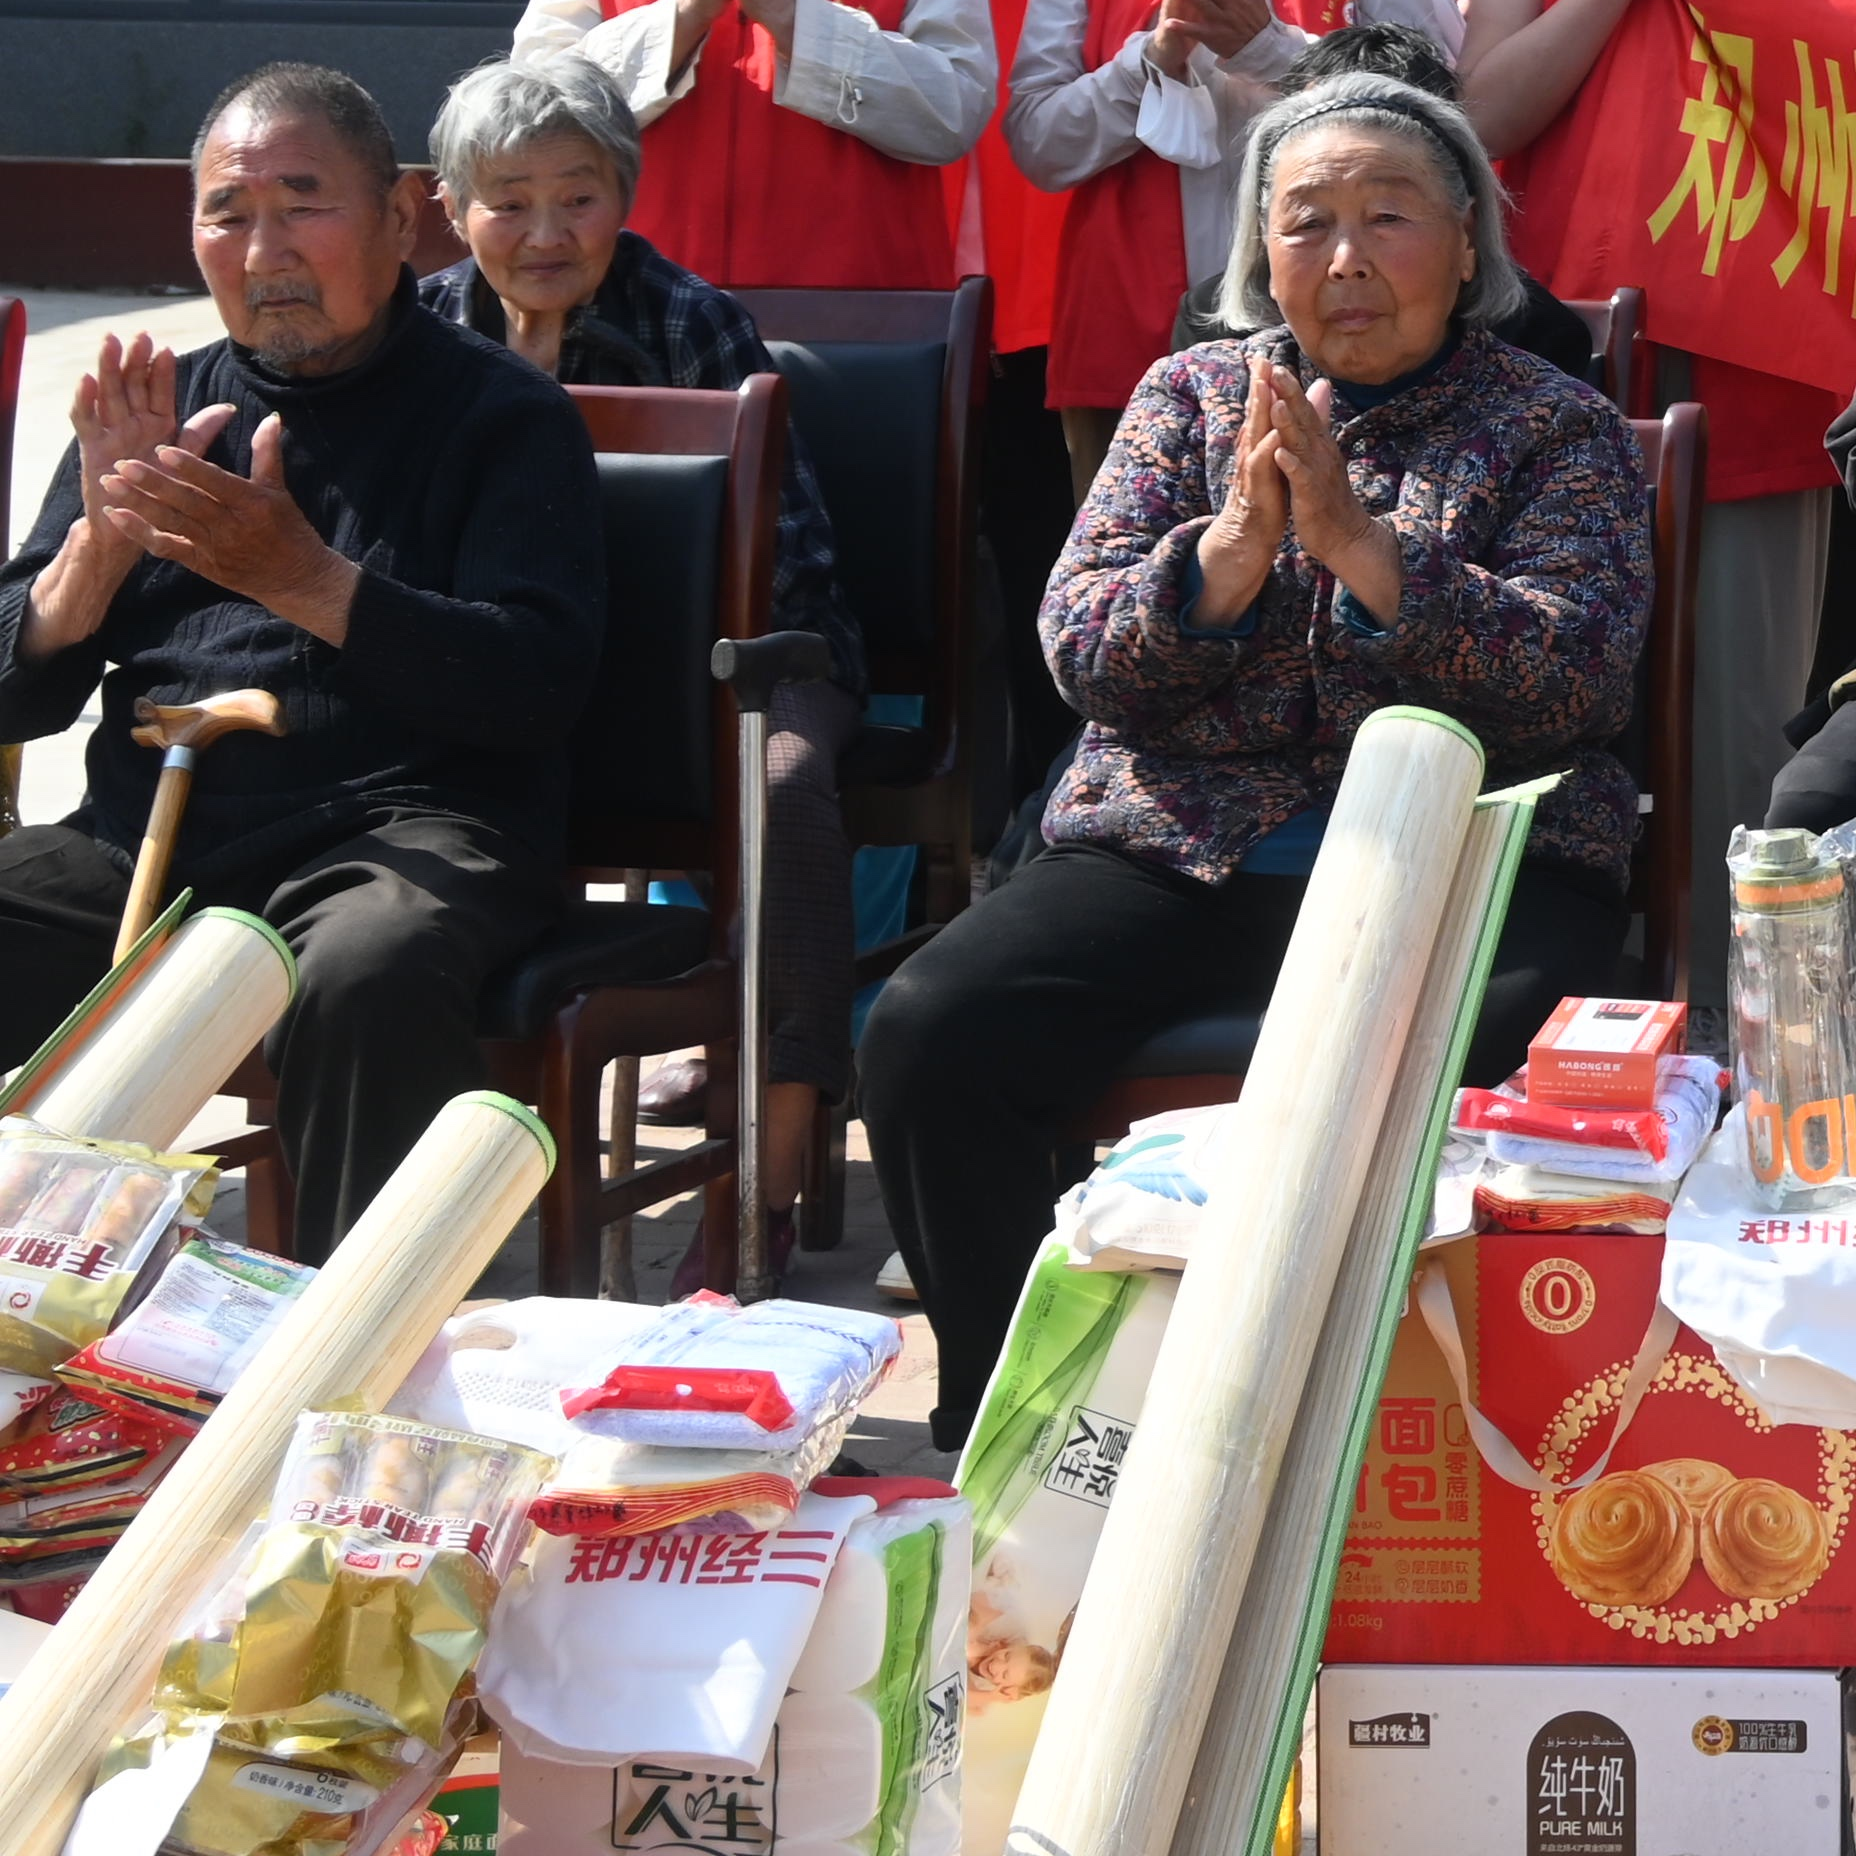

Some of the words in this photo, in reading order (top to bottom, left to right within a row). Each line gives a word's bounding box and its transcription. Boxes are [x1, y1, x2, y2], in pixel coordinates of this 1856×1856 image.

[1354, 1723, 1426, 1742] 疆村牧业
[1538, 1755, 1625, 1816] 纯牛奶
[1539, 1821, 1582, 1836] PURE
[1587, 1821, 1623, 1836] MILK
